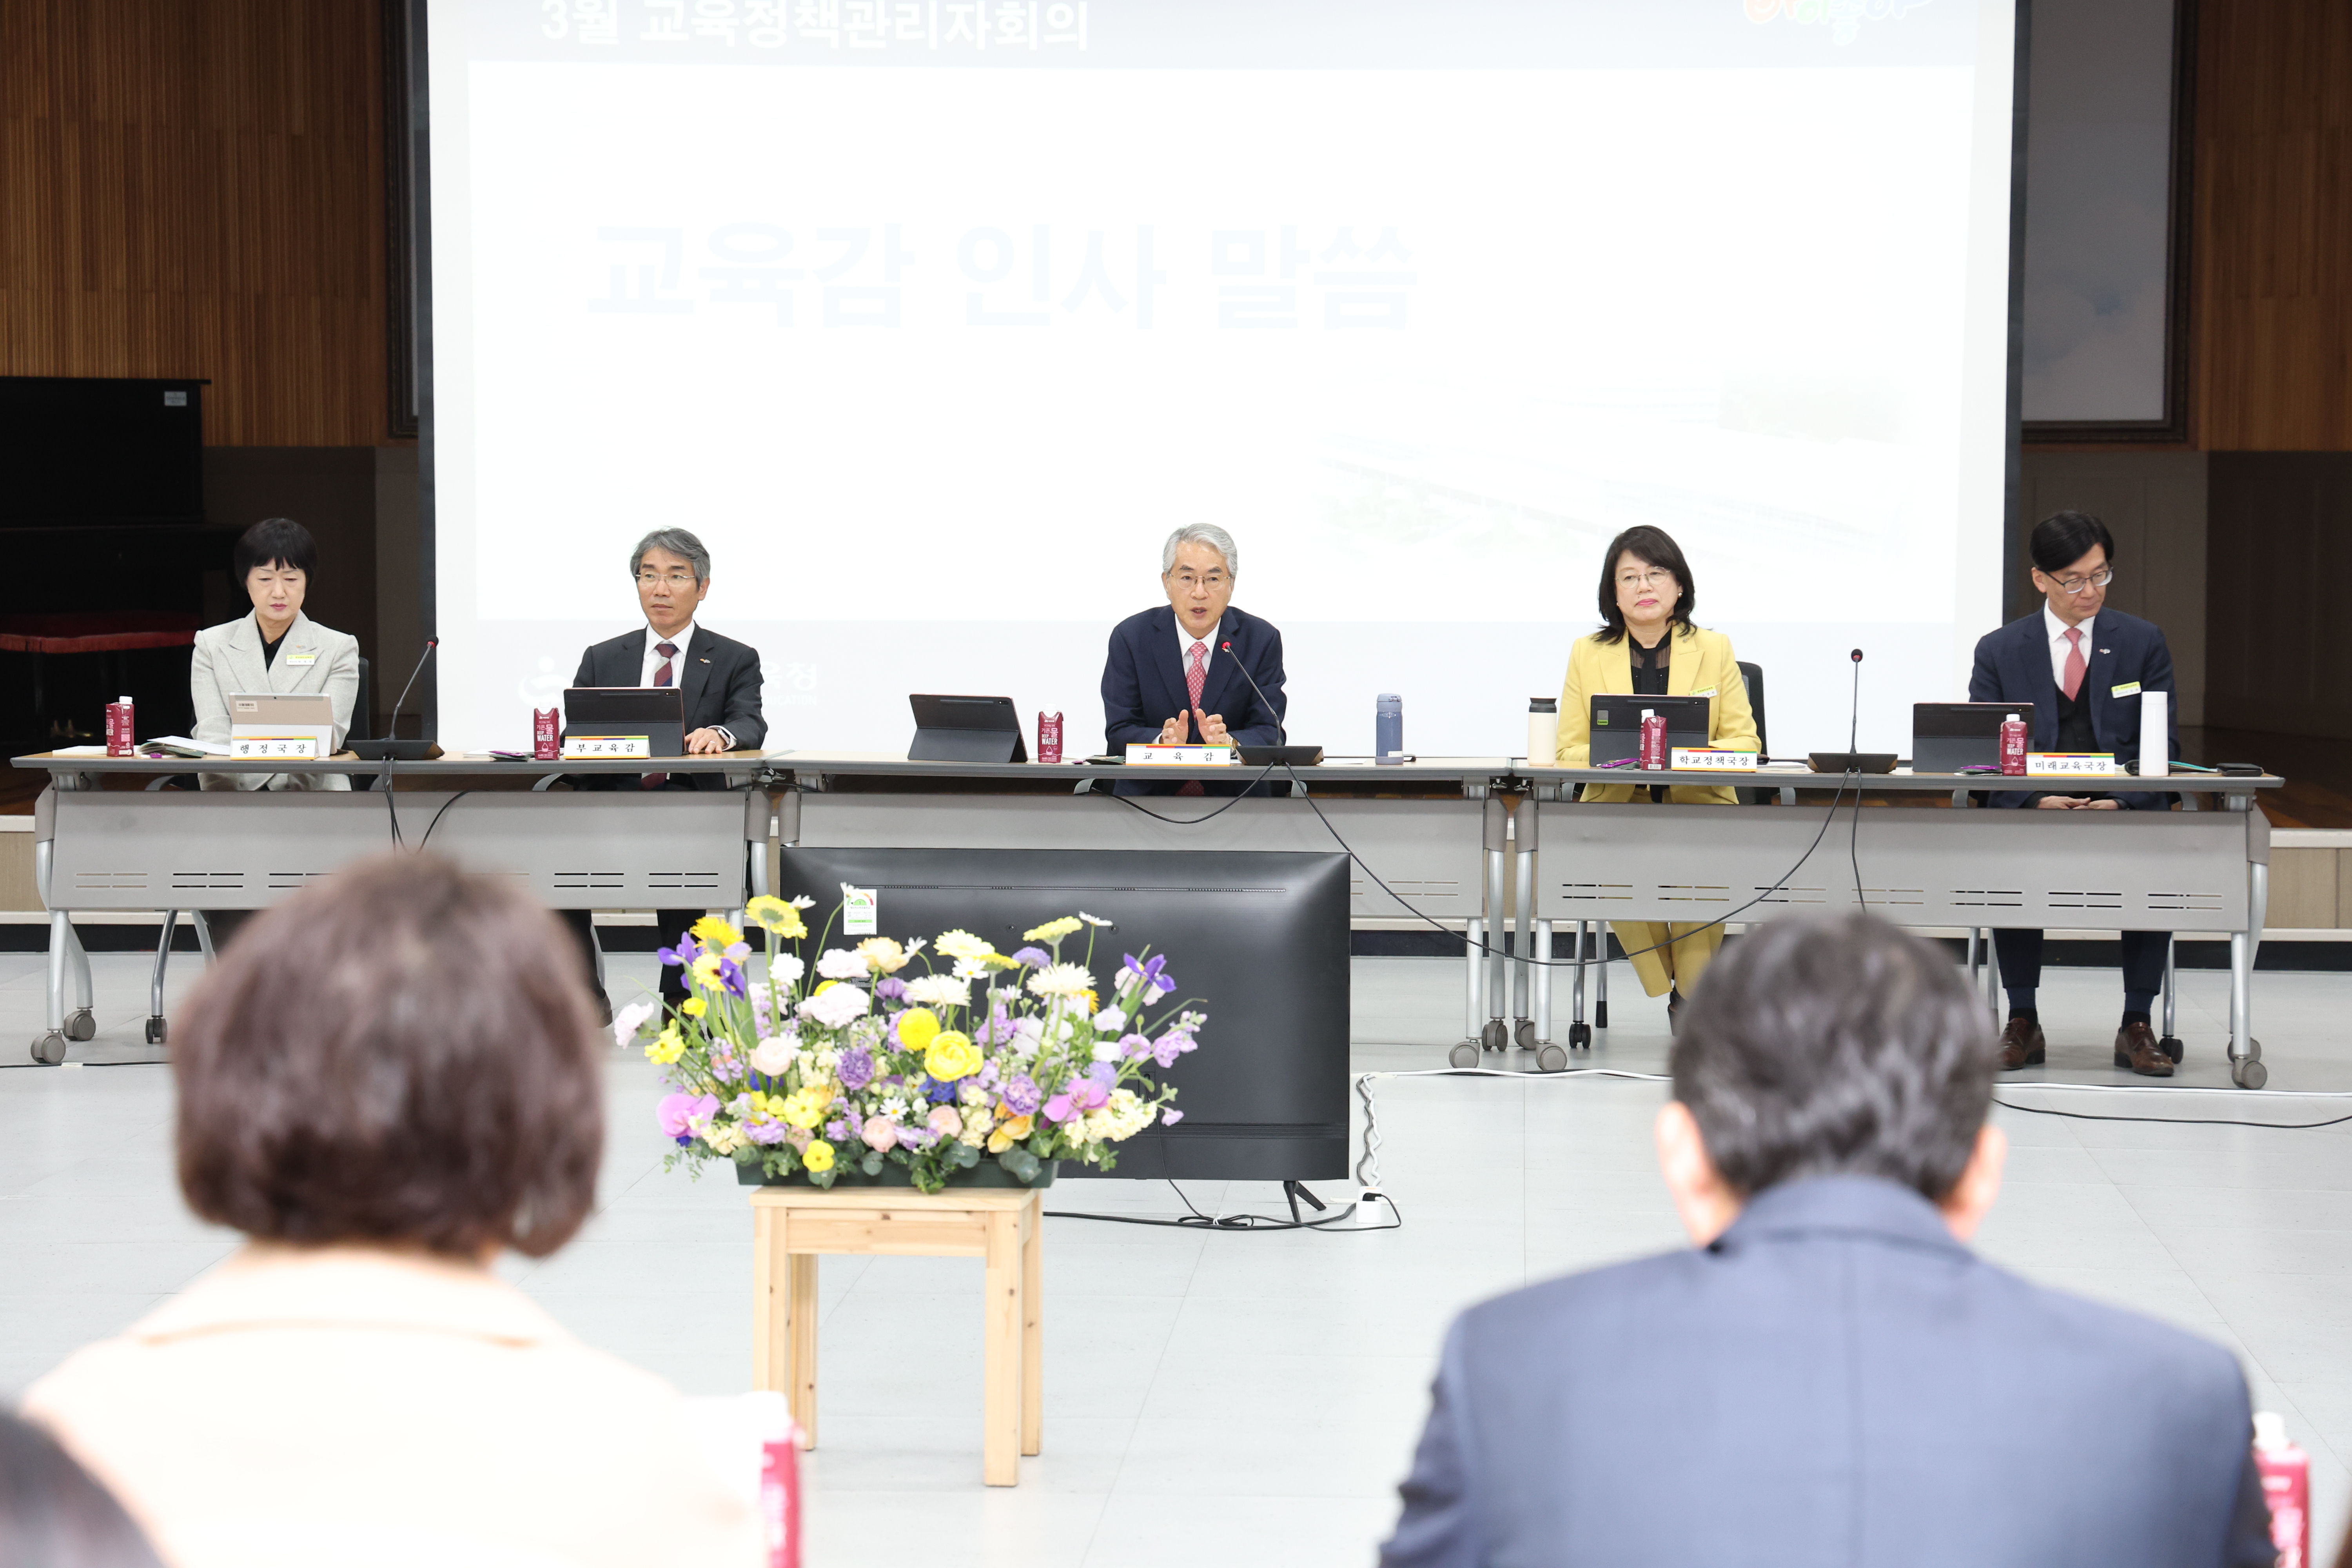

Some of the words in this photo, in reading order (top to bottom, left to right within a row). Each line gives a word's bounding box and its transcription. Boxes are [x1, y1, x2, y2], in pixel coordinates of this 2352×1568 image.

[541, 0, 619, 44] 3월
[640, 0, 1087, 51] 교육정책관리자회의
[587, 222, 915, 329] 교육감
[955, 222, 1167, 330] 인사
[1210, 223, 1418, 330] 말씀
[762, 695, 818, 706] DUCATION
[1050, 728, 1058, 738] 물
[240, 744, 307, 754] 행정국장
[576, 743, 635, 753] 부교육감
[1679, 755, 1749, 766] 학교정책국장
[2035, 760, 2107, 771] 미래교육국장
